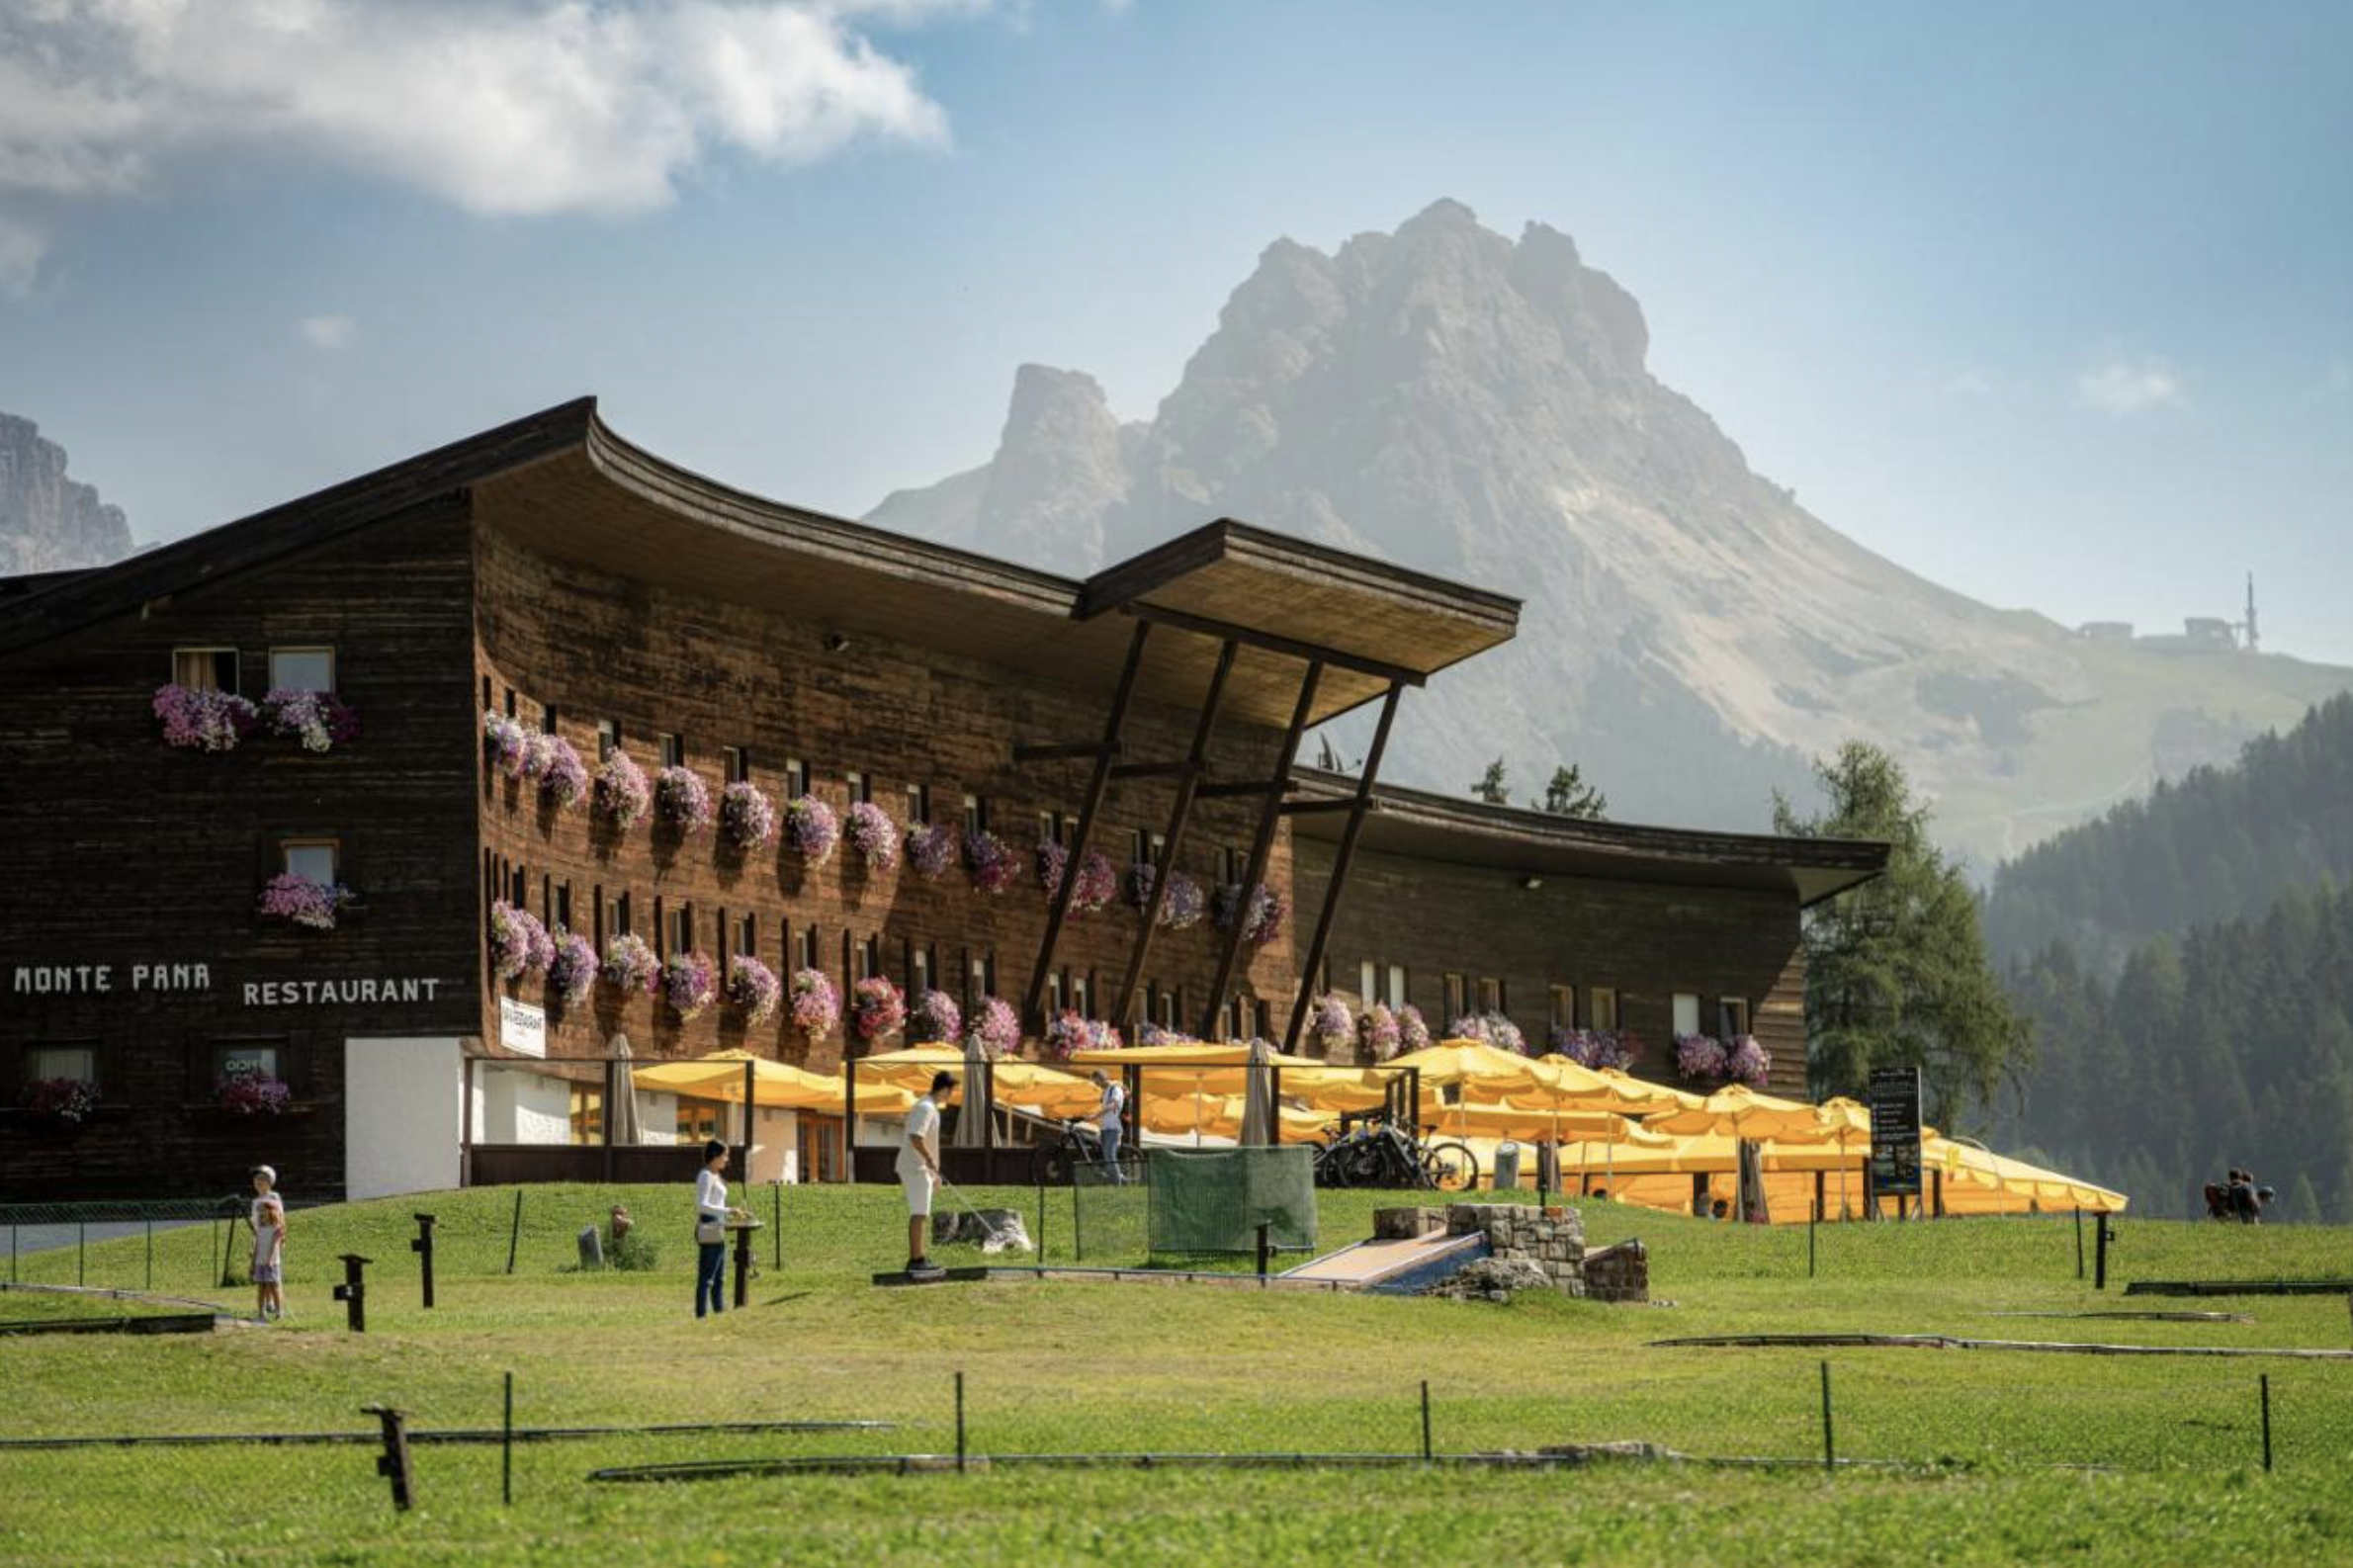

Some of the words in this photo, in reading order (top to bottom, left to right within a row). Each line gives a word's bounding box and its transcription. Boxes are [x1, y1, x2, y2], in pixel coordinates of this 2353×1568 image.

[15, 966, 112, 995] MONTE
[132, 963, 210, 992] PANA
[243, 978, 439, 1005] RESTAURANT
